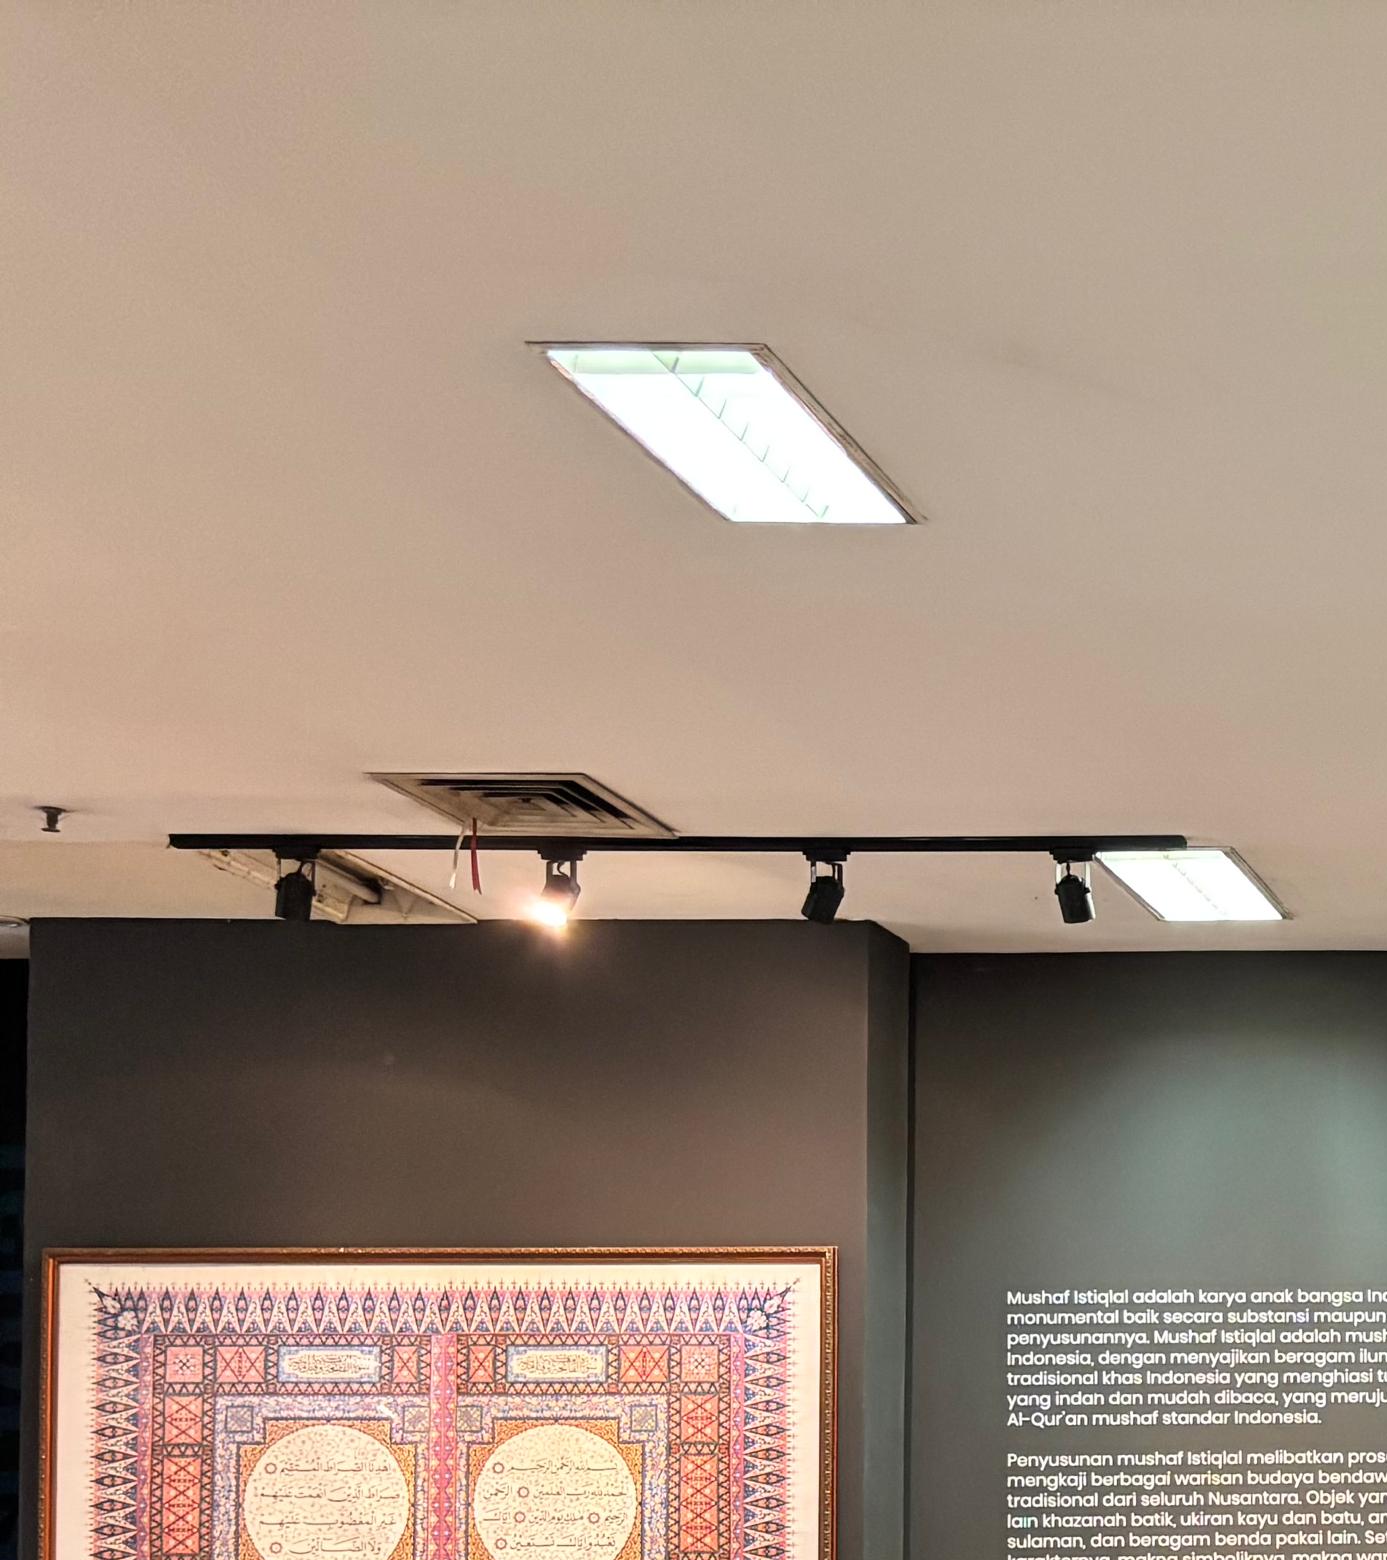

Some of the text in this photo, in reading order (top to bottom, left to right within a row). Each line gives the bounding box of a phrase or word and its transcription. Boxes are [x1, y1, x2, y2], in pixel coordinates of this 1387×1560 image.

[1007, 1289, 1071, 1304] Mushaf
[1073, 1288, 1129, 1308] Istiqlal
[1132, 1288, 1195, 1304] adalah
[1198, 1288, 1247, 1308] karya
[1250, 1288, 1294, 1303] anak
[1297, 1288, 1364, 1307] bangsa
[1006, 1309, 1119, 1325] monumental
[1123, 1309, 1160, 1325] baik
[1162, 1313, 1224, 1324] secara
[1227, 1308, 1310, 1324] substansi
[1313, 1312, 1387, 1327] maupun
[1007, 1333, 1151, 1349] penyusunannya.
[1153, 1329, 1218, 1344] Mushaf
[1220, 1328, 1276, 1348] Istiqlal
[1279, 1328, 1342, 1344] adalah
[1007, 1350, 1095, 1367] Indonesia,
[1097, 1349, 1167, 1369] dengan
[1169, 1348, 1271, 1368] menyajikan
[1274, 1348, 1356, 1368] beragam
[1006, 1369, 1098, 1385] tradisional
[1102, 1369, 1143, 1385] khas
[1146, 1369, 1231, 1384] Indonesia
[1234, 1373, 1279, 1388] yang
[1282, 1368, 1373, 1388] menghiasi
[1006, 1395, 1051, 1411] yang
[1055, 1390, 1105, 1406] indah
[1108, 1390, 1143, 1406] dan
[1147, 1389, 1211, 1405] mudah
[1214, 1389, 1279, 1407] dibaca,
[1282, 1393, 1327, 1408] yang
[1006, 1409, 1322, 1427] Al-Qur'an mushaf standar Indonesia.
